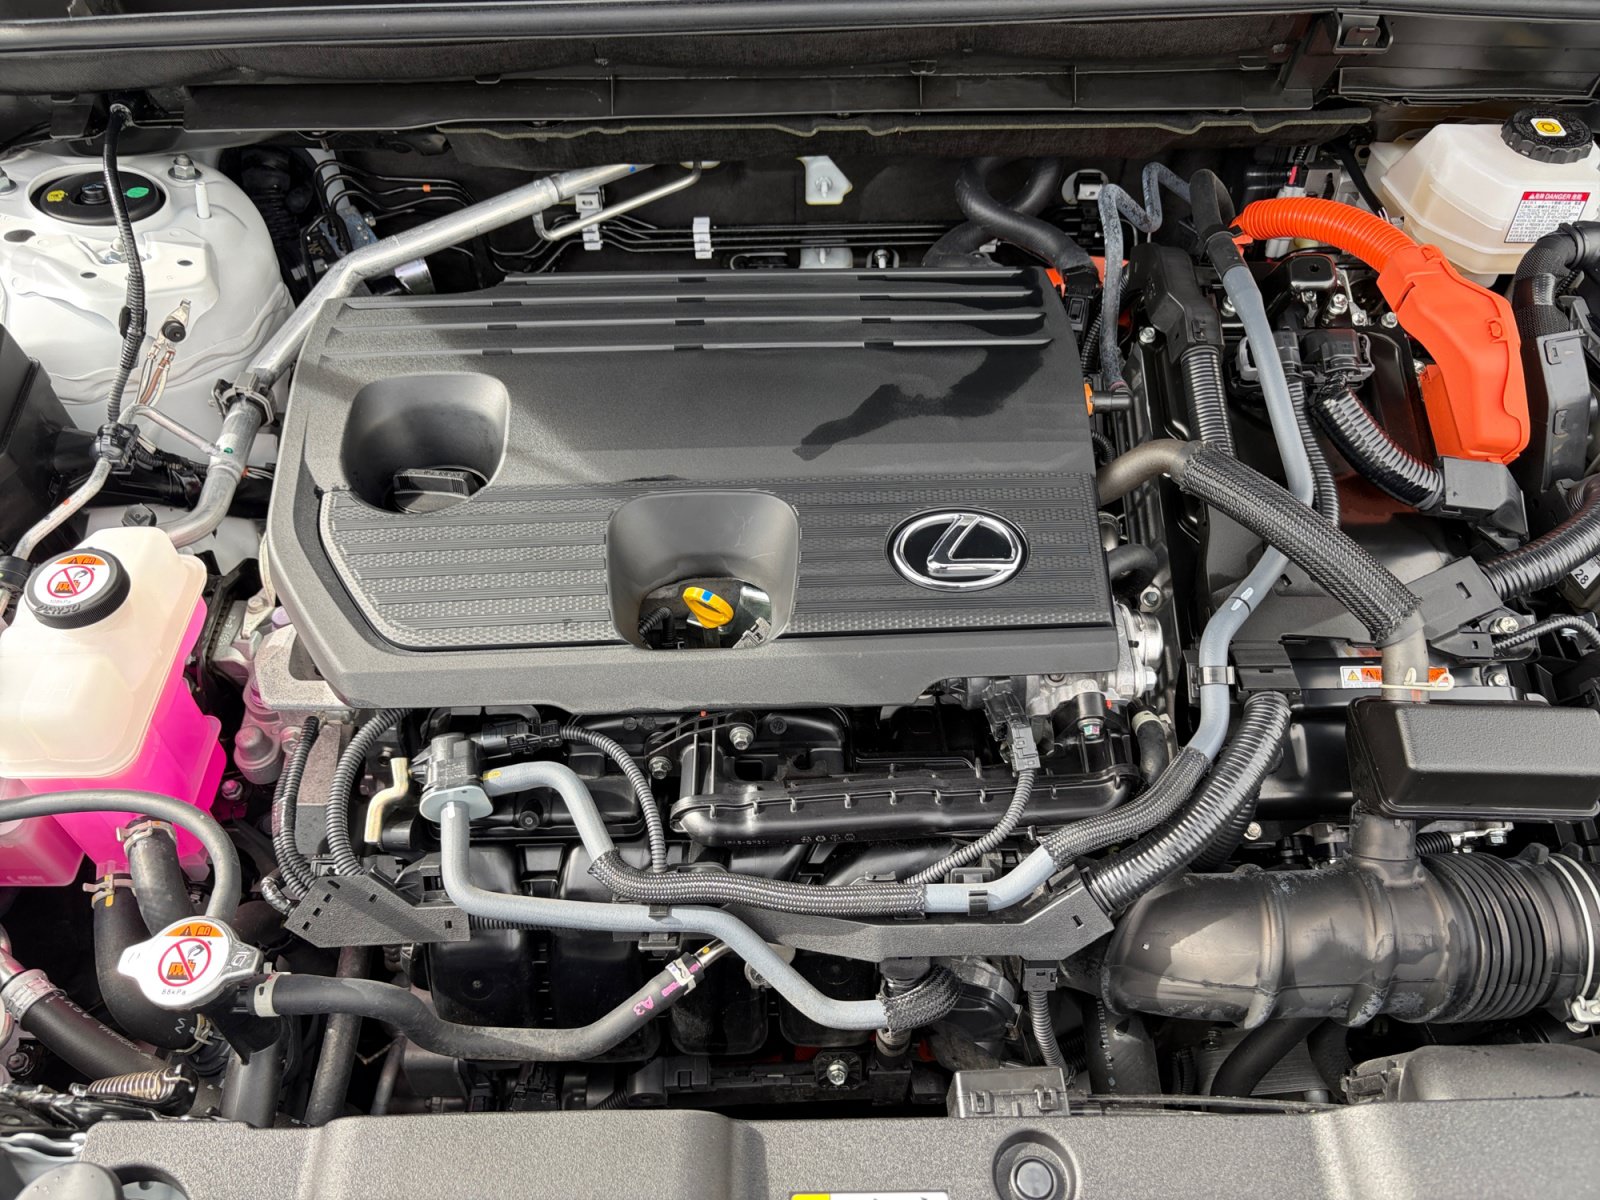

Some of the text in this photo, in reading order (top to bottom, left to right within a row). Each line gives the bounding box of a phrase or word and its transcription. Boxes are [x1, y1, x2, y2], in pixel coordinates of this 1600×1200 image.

[1574, 568, 1589, 585] 28
[36, 603, 80, 614] DENSO
[633, 995, 655, 1016] A3
[98, 1024, 142, 1053] YOKOHAMA
